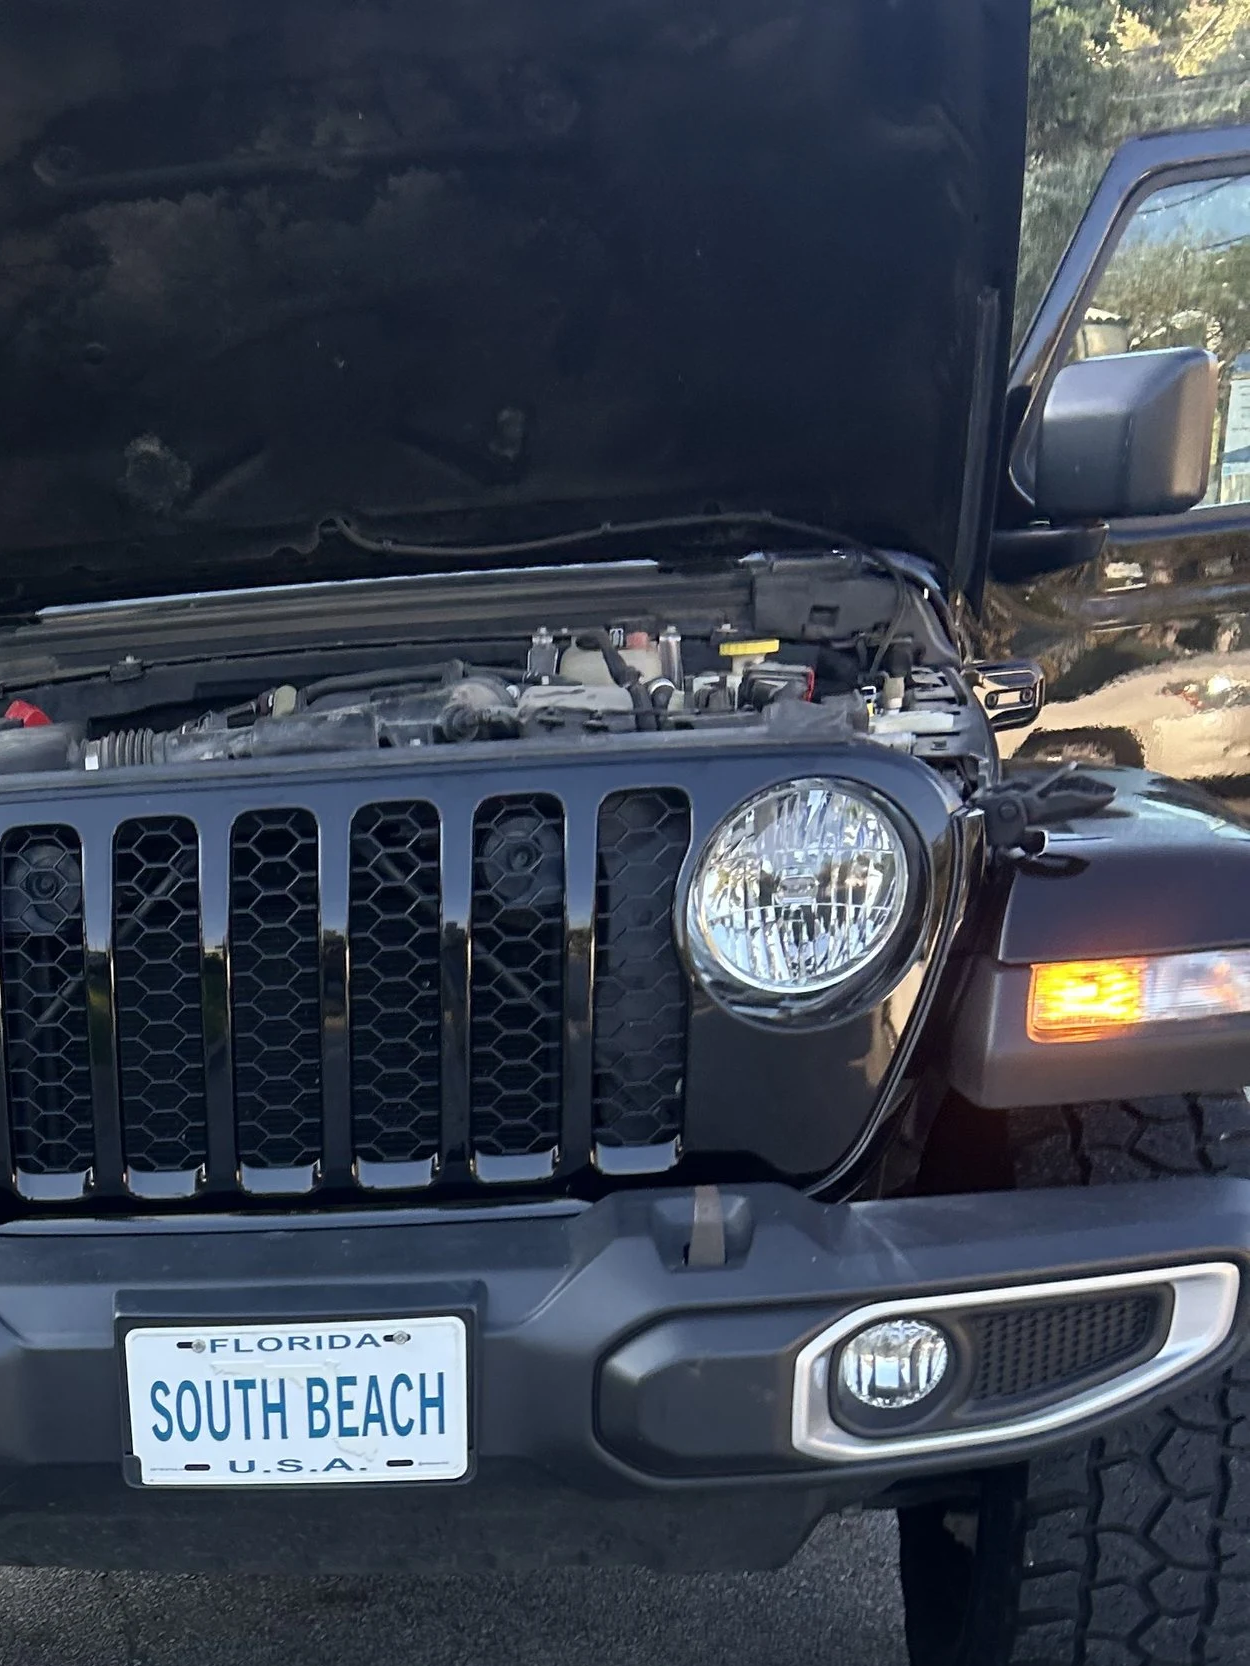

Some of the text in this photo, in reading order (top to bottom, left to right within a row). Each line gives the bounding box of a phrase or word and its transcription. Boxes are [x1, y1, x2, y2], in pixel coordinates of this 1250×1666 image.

[209, 1333, 382, 1354] FLORIDA
[151, 1371, 446, 1442] SOUTH BEACH
[229, 1457, 368, 1474] U.S.A.
